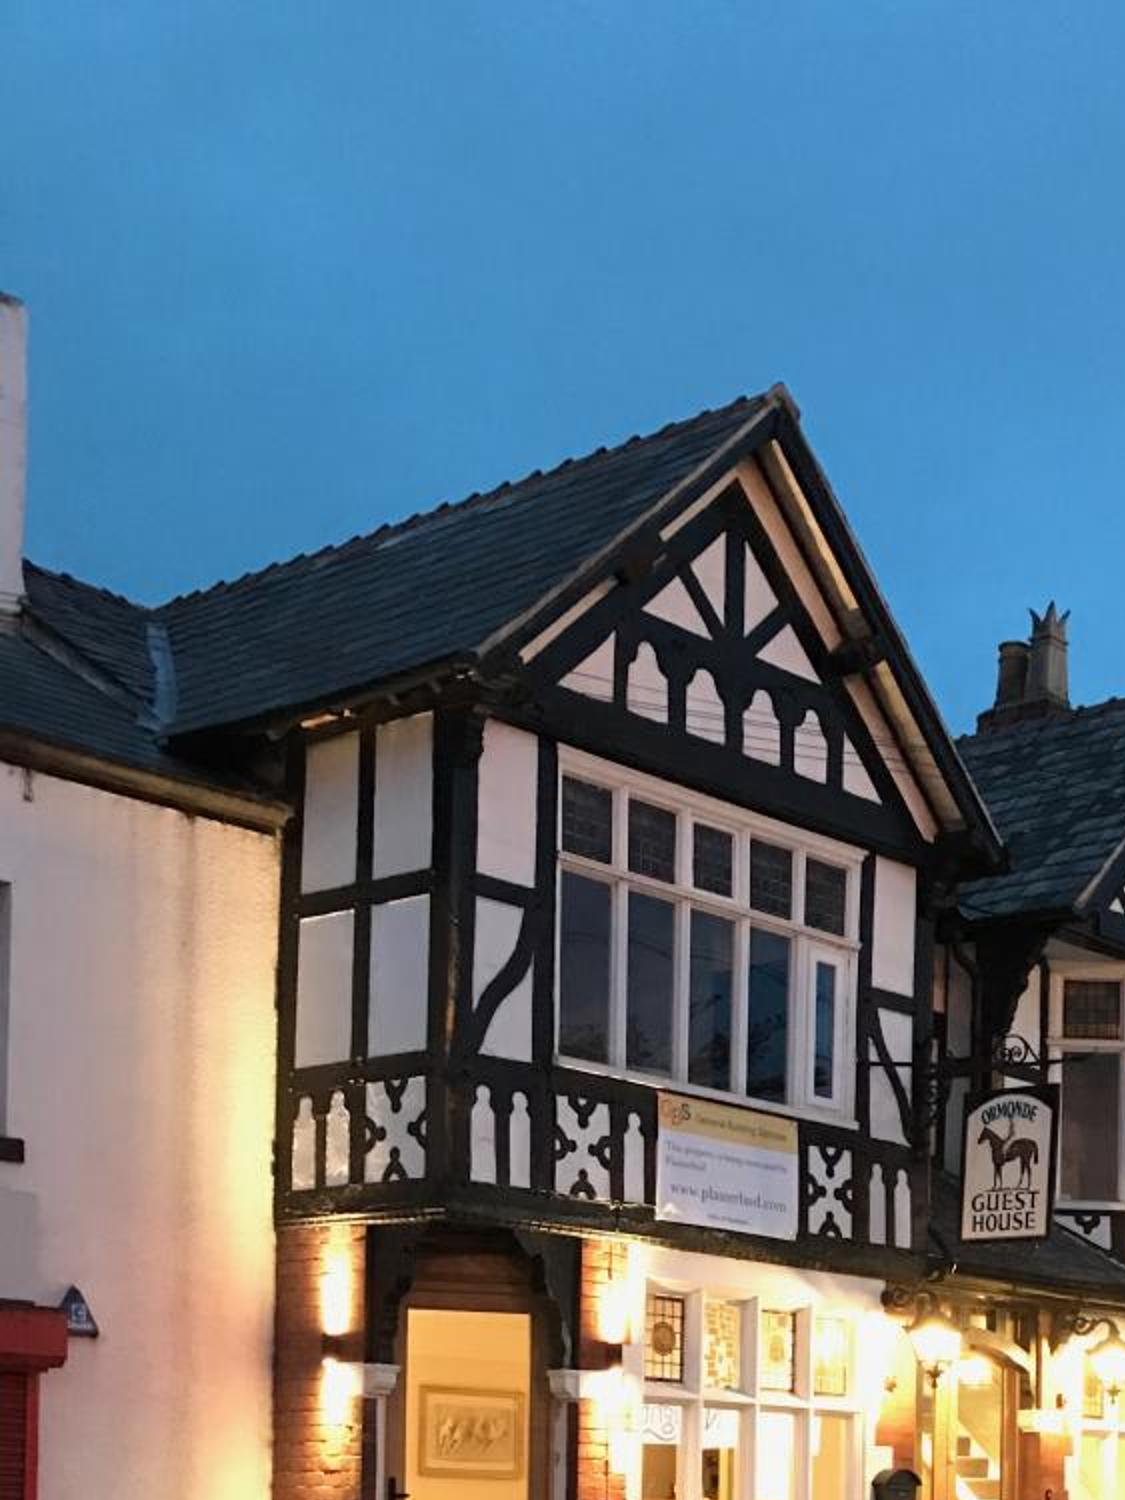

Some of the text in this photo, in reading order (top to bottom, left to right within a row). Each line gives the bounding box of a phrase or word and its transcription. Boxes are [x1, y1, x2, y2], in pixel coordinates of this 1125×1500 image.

[982, 1101, 1039, 1125] ORMONDE
[971, 1191, 1040, 1213] GUEST
[971, 1211, 1036, 1233] HOUSE
